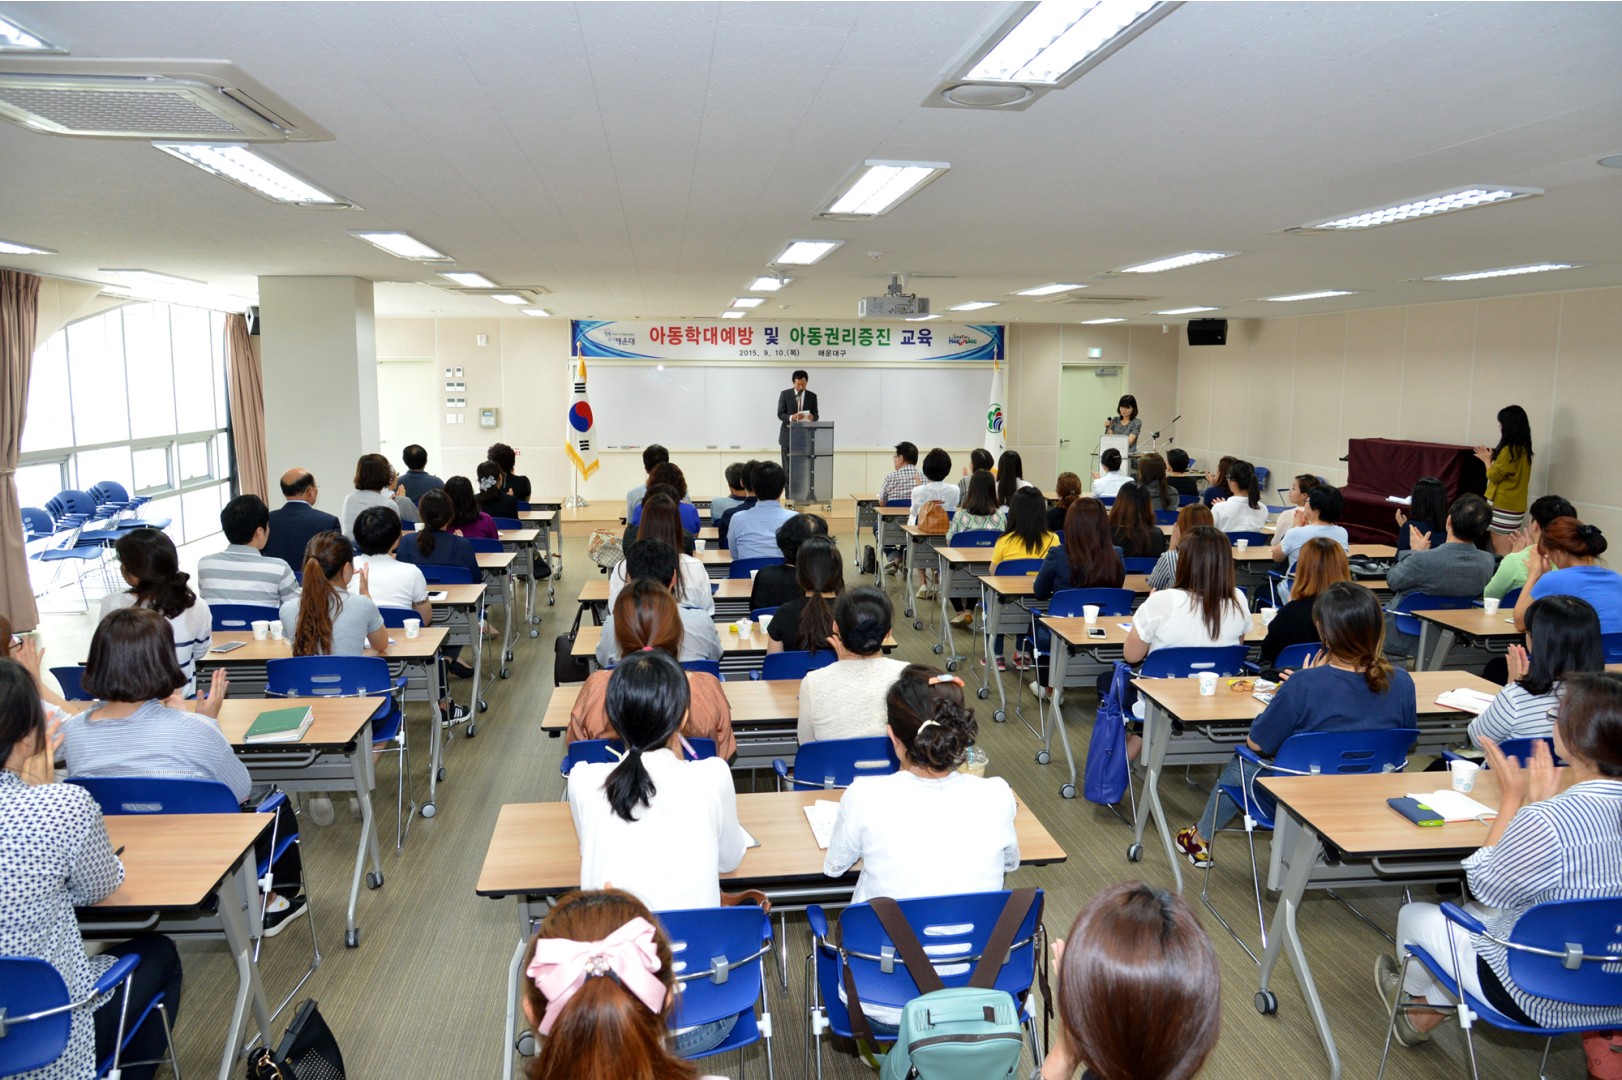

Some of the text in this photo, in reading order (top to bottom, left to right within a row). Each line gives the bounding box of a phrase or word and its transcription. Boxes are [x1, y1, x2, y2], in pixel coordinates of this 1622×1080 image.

[649, 326, 933, 347] 아동학대예방 및 아동권리증진 교육
[739, 349, 760, 357] 2015.
[763, 349, 772, 357] 9.
[817, 349, 847, 358] 해운대구
